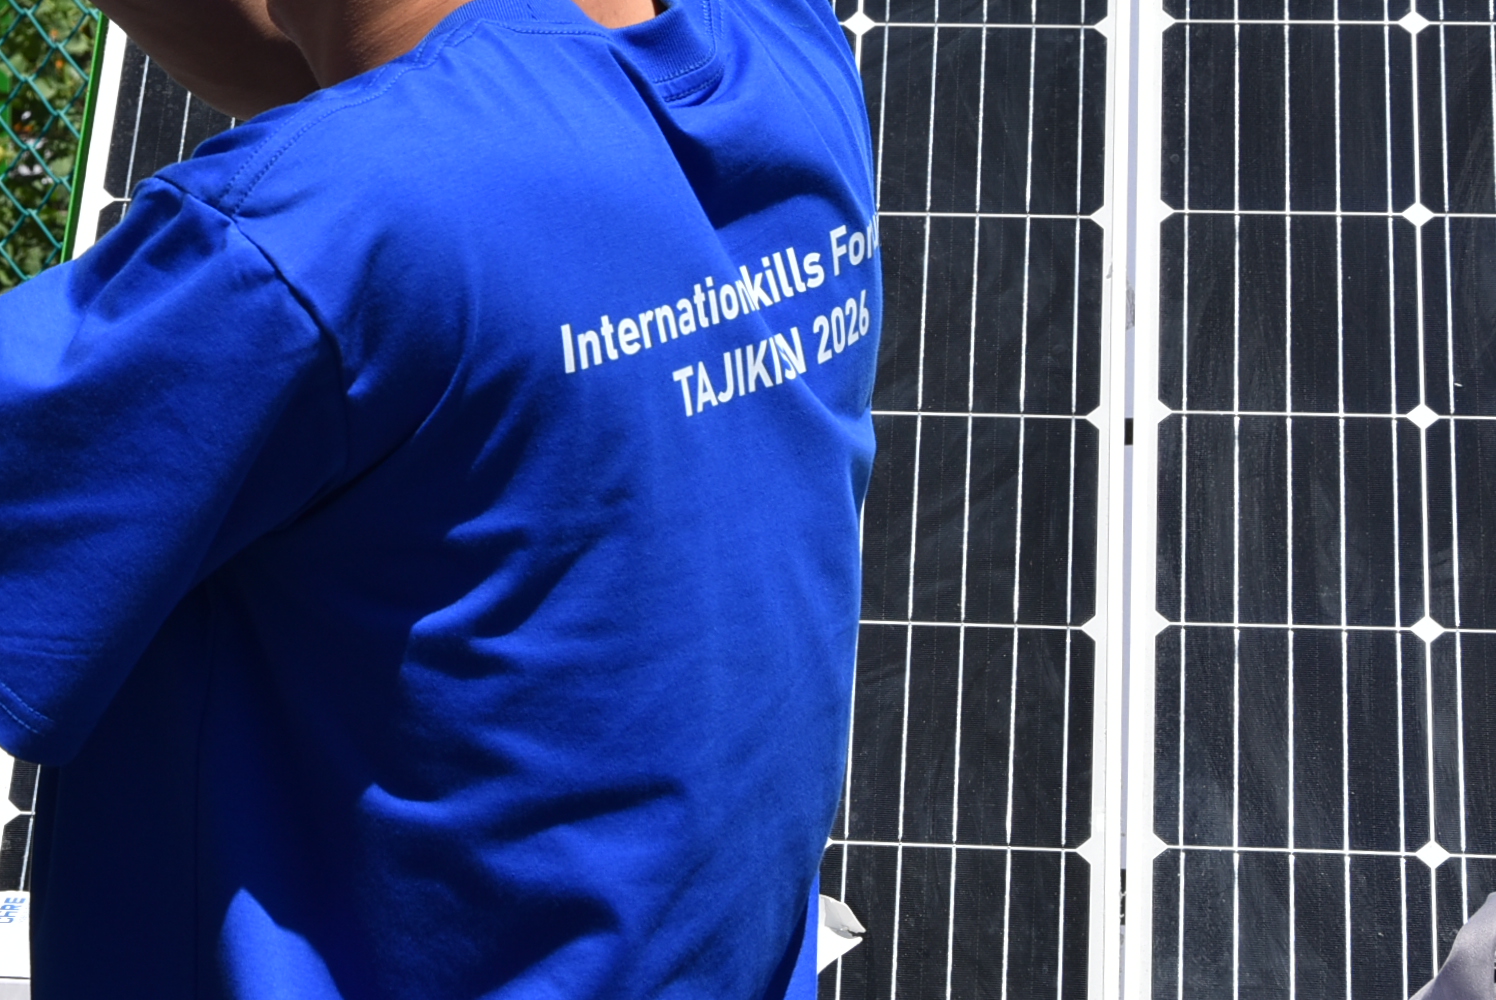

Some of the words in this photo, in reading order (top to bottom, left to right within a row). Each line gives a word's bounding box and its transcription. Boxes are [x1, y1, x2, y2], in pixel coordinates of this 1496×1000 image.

[561, 276, 757, 375] Internation
[739, 246, 825, 311] kills
[813, 289, 870, 365] 2026
